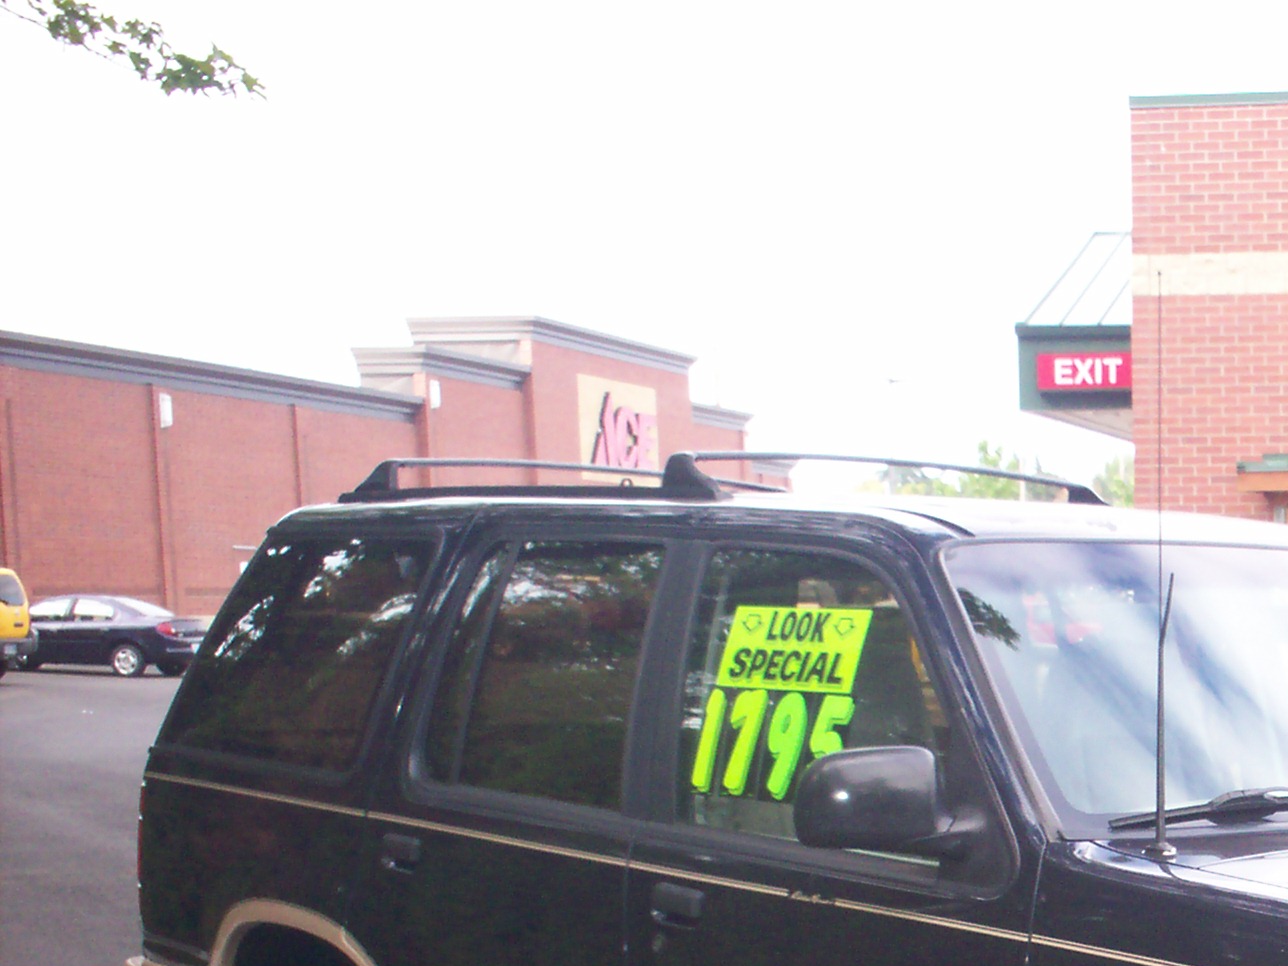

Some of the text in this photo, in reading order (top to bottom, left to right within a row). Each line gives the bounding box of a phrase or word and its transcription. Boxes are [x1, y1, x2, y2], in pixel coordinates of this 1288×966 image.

[1053, 357, 1123, 385] EXIT
[766, 610, 831, 643] LOOK
[729, 647, 844, 685] SPECIAL
